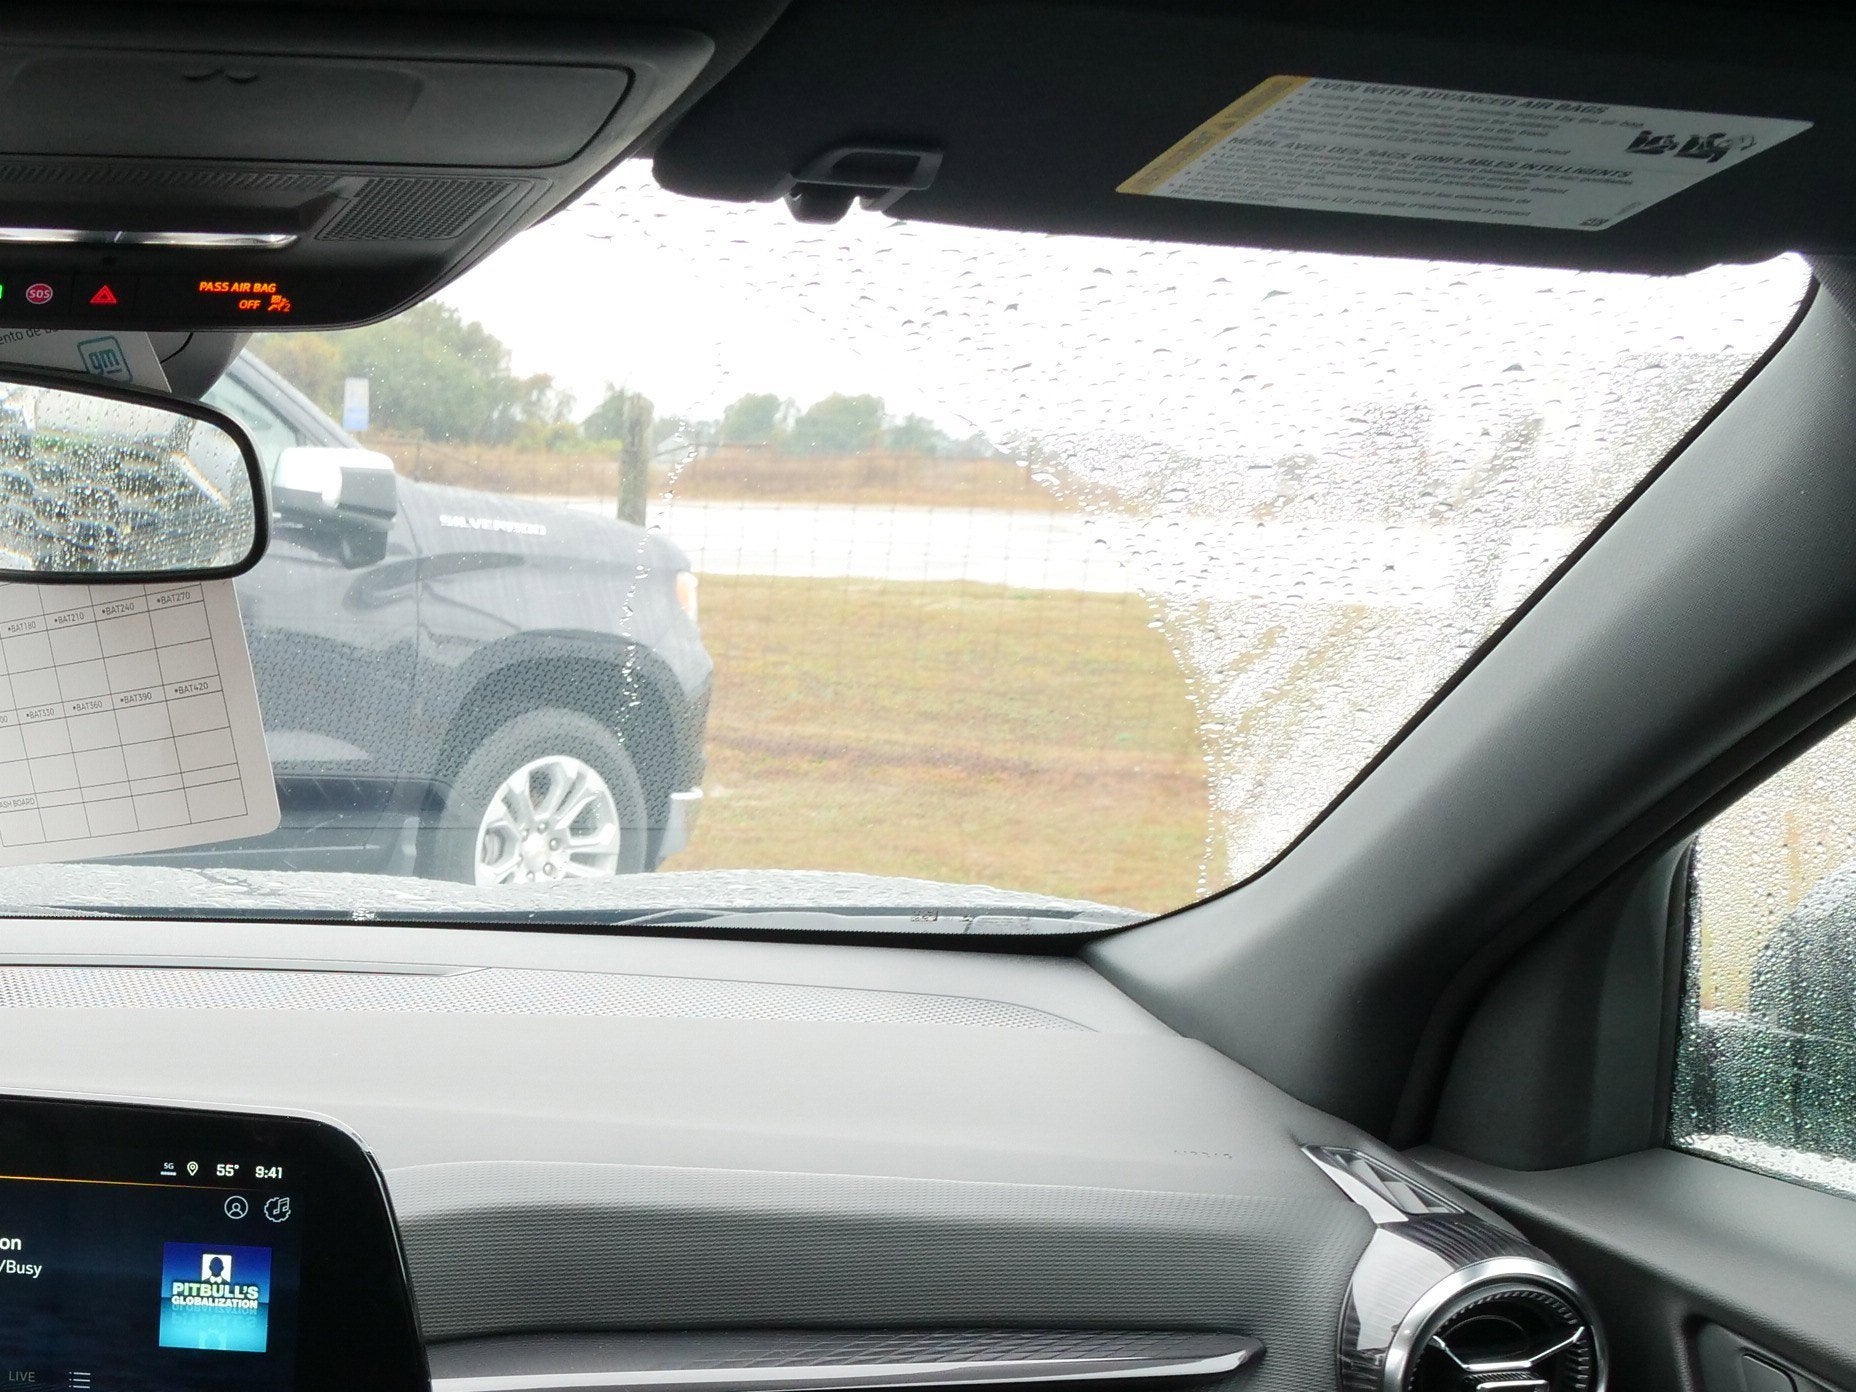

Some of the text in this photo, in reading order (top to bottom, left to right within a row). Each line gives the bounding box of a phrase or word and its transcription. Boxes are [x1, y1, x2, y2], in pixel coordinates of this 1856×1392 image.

[29, 288, 50, 299] SOS
[199, 282, 277, 294] PASS AIR BAG
[238, 299, 261, 310] OFF
[26, 327, 41, 338] de
[89, 348, 121, 371] gm
[13, 798, 36, 809] BOARD
[164, 1162, 175, 1170] 5G
[216, 1164, 240, 1176] 55°
[256, 1166, 284, 1179] 9:41
[173, 1281, 259, 1300] PITBULL'S
[171, 1295, 258, 1310] GLOBALIZATION
[8, 1371, 36, 1383] LIVE
